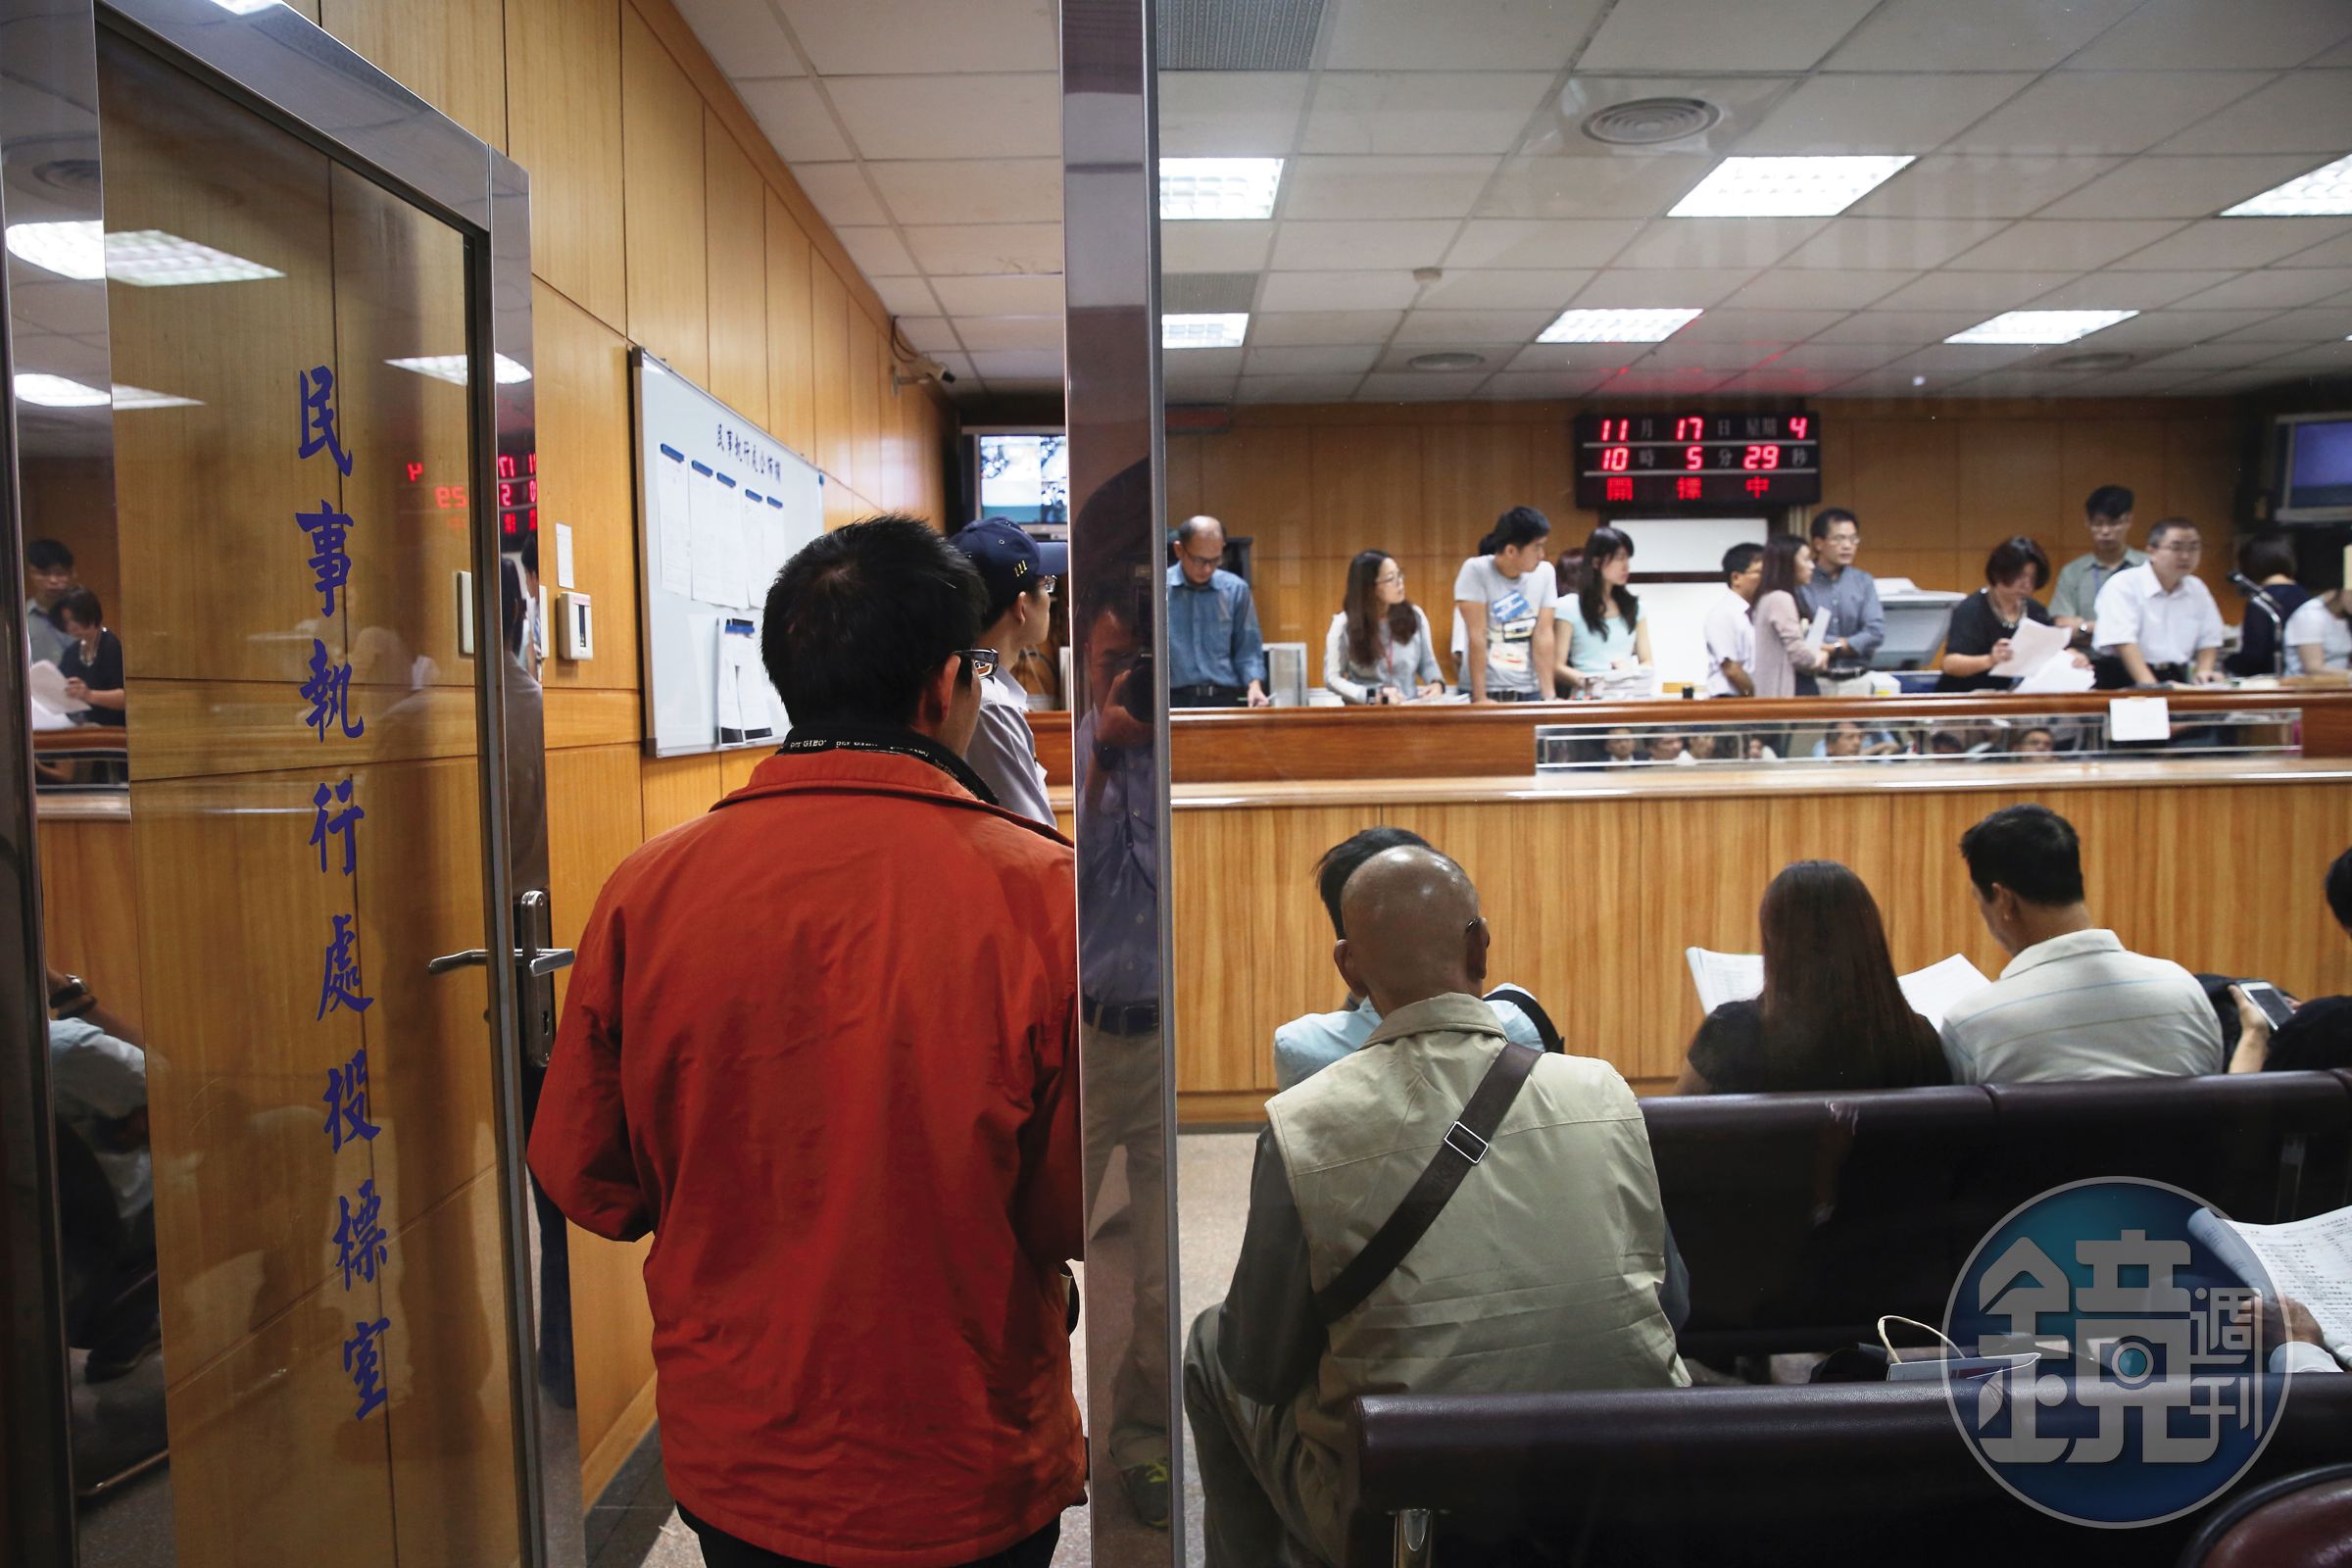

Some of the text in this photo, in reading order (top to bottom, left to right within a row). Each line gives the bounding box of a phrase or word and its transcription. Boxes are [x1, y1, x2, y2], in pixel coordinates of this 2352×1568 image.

[1601, 418, 1629, 441] 11
[1676, 416, 1703, 441] 17
[1789, 416, 1807, 439] 4
[1601, 447, 1629, 471] 10
[1685, 445, 1703, 470] 5
[1742, 445, 1780, 470] 29
[295, 365, 390, 1420] 民事執行處投標室
